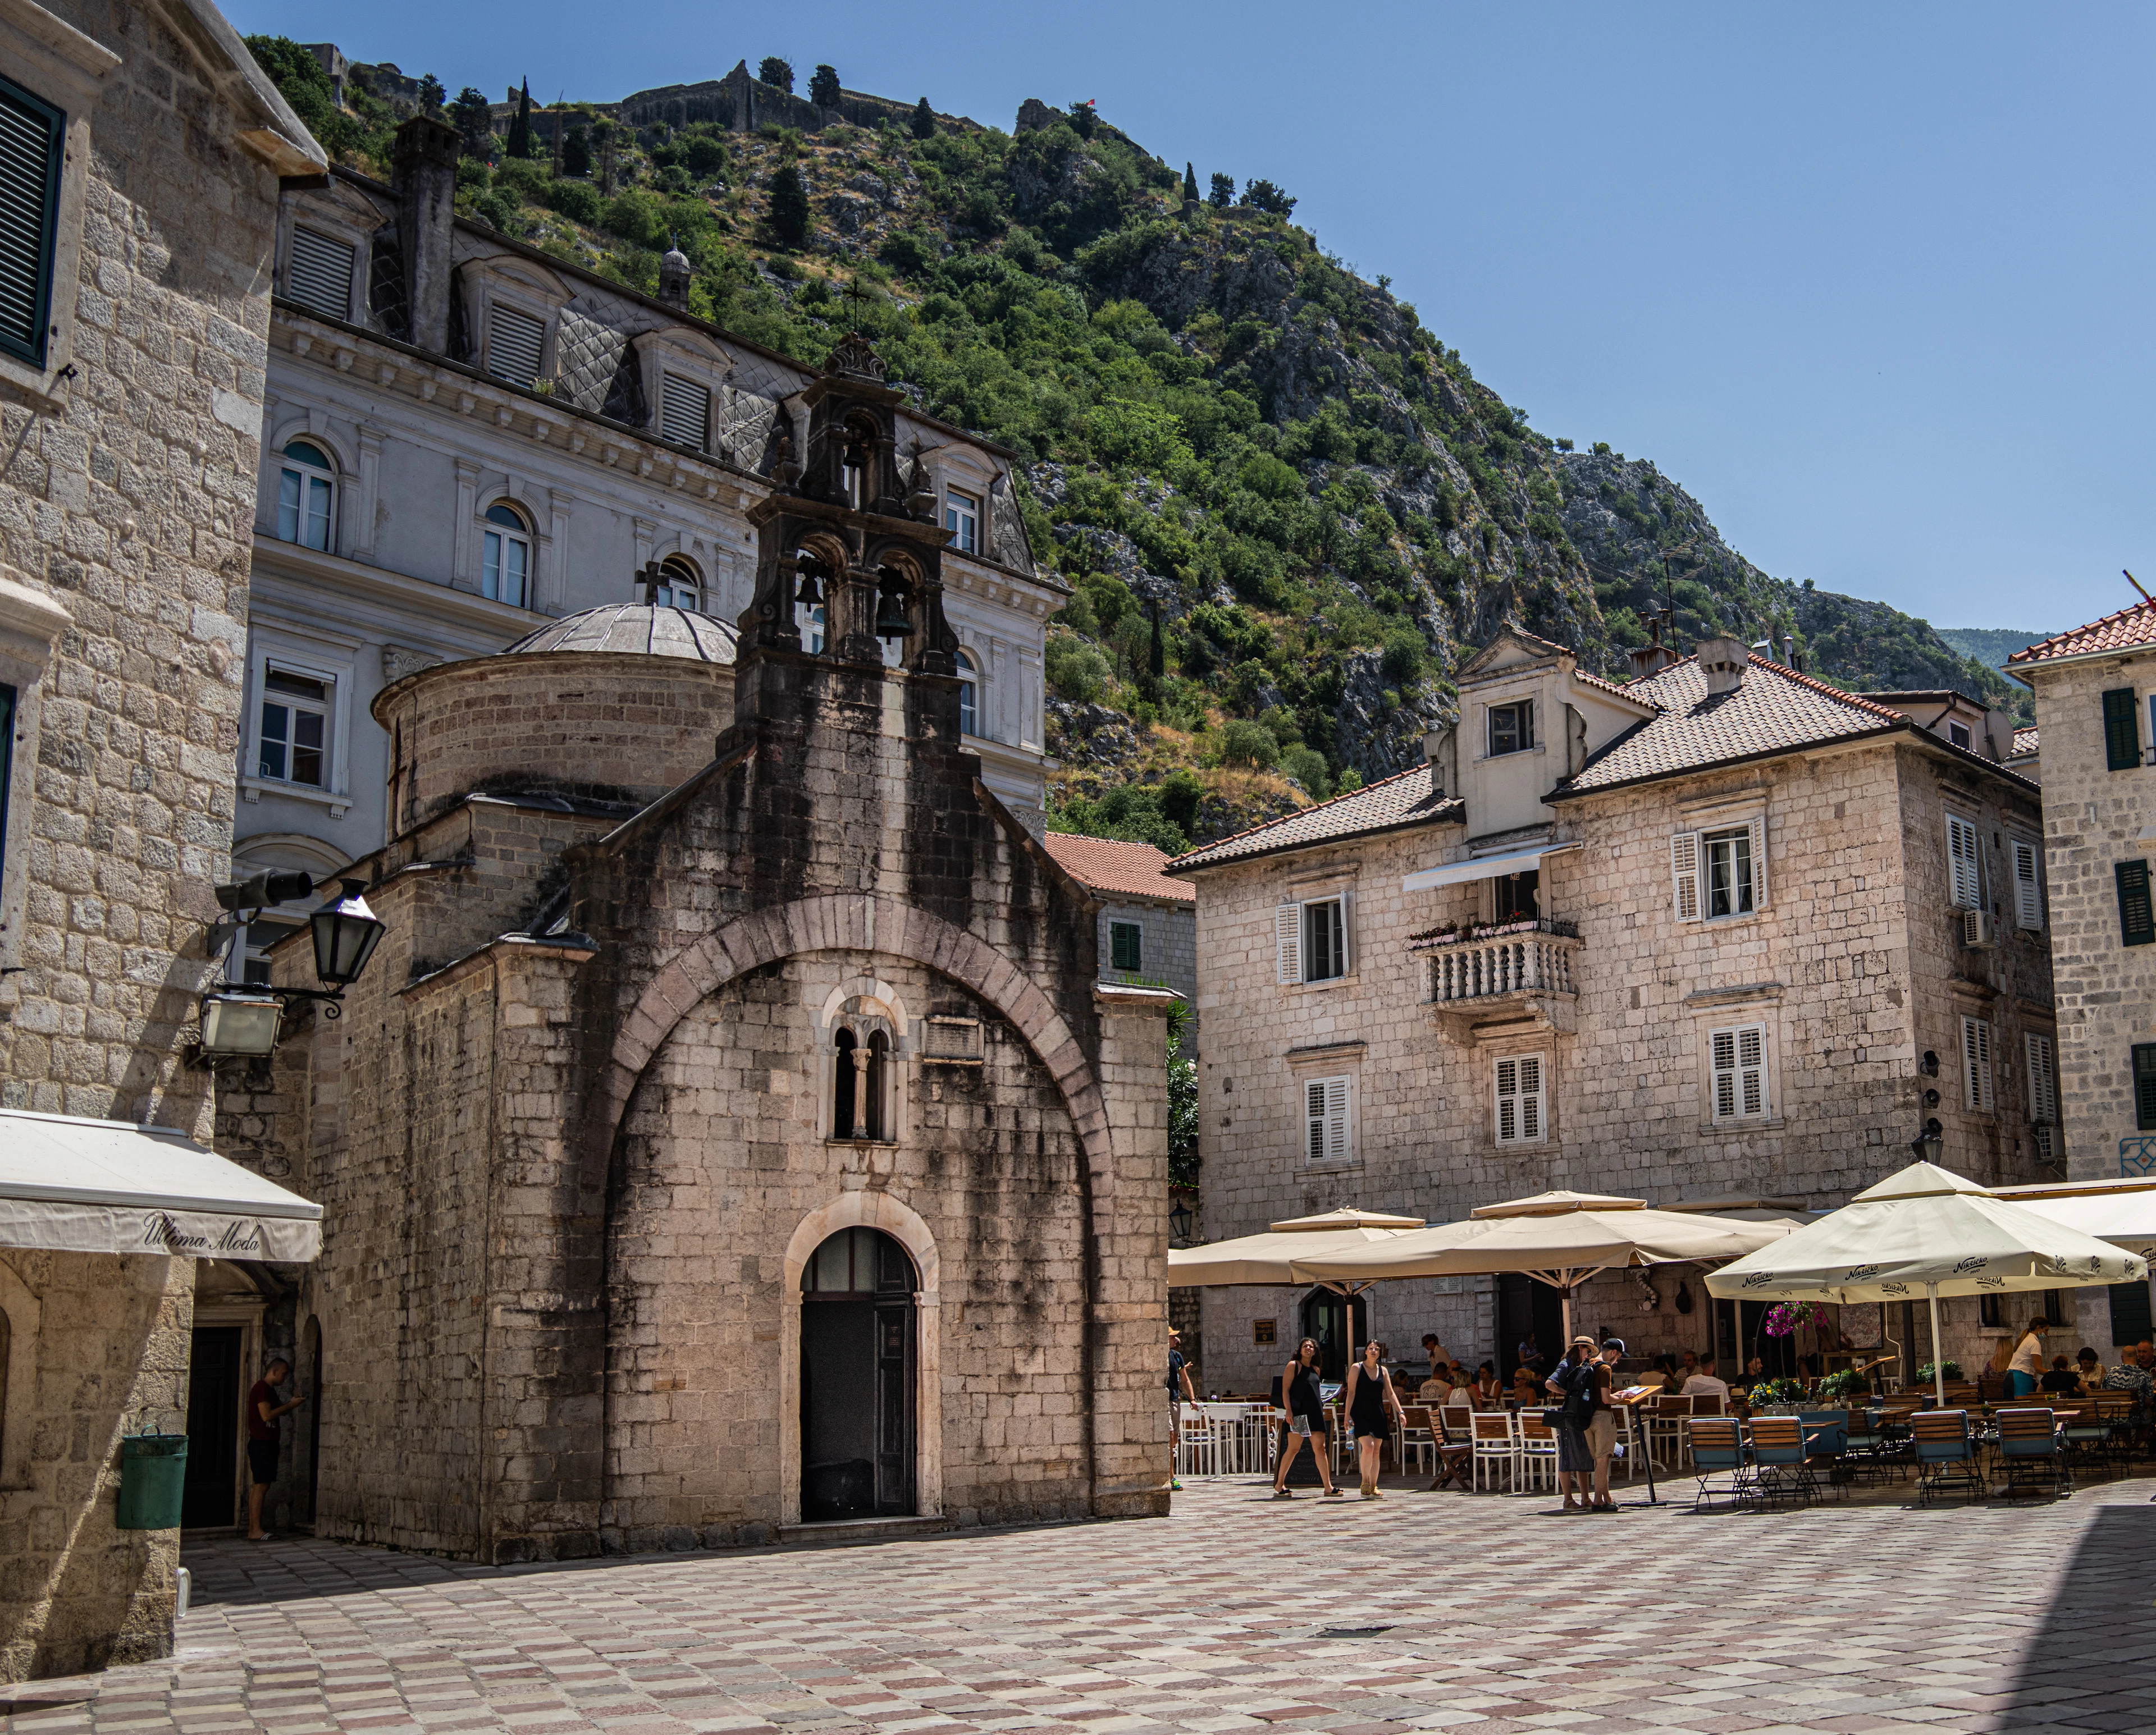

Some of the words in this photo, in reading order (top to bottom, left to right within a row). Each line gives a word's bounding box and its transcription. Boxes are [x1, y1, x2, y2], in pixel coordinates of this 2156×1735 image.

[144, 1214, 207, 1248] Ultima
[209, 1221, 259, 1251] Moda
[1845, 1265, 1878, 1280] Nikšičko
[1953, 1256, 1988, 1273] Nikšičko
[1742, 1271, 1773, 1288] Nikšičko
[1856, 1333, 1879, 1344] PIZZA
